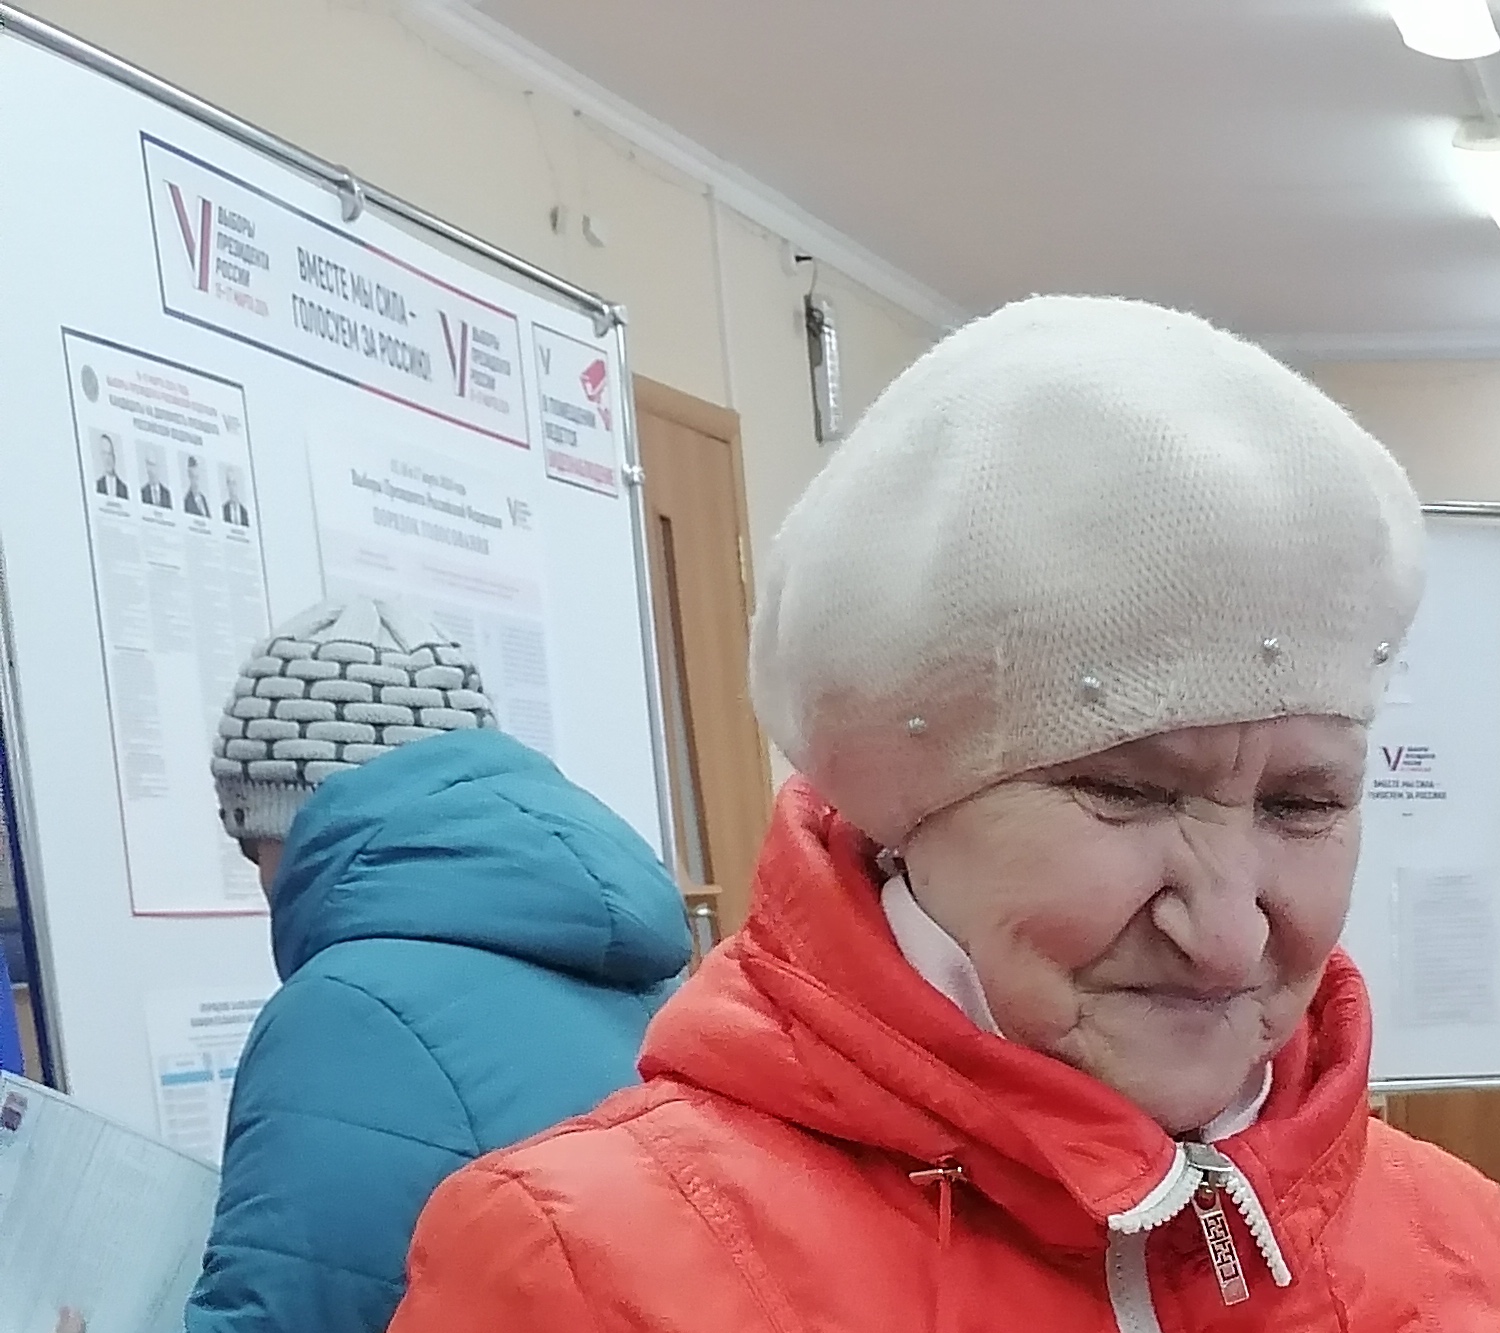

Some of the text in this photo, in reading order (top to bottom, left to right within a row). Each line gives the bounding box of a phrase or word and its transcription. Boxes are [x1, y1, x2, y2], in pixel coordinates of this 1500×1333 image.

[297, 246, 350, 302] ВМЕСТЕ
[350, 271, 375, 312] МЫ
[375, 283, 408, 327] СИЛА
[292, 293, 361, 352] ГОЛОСУЕМ
[361, 324, 377, 360] ЗА
